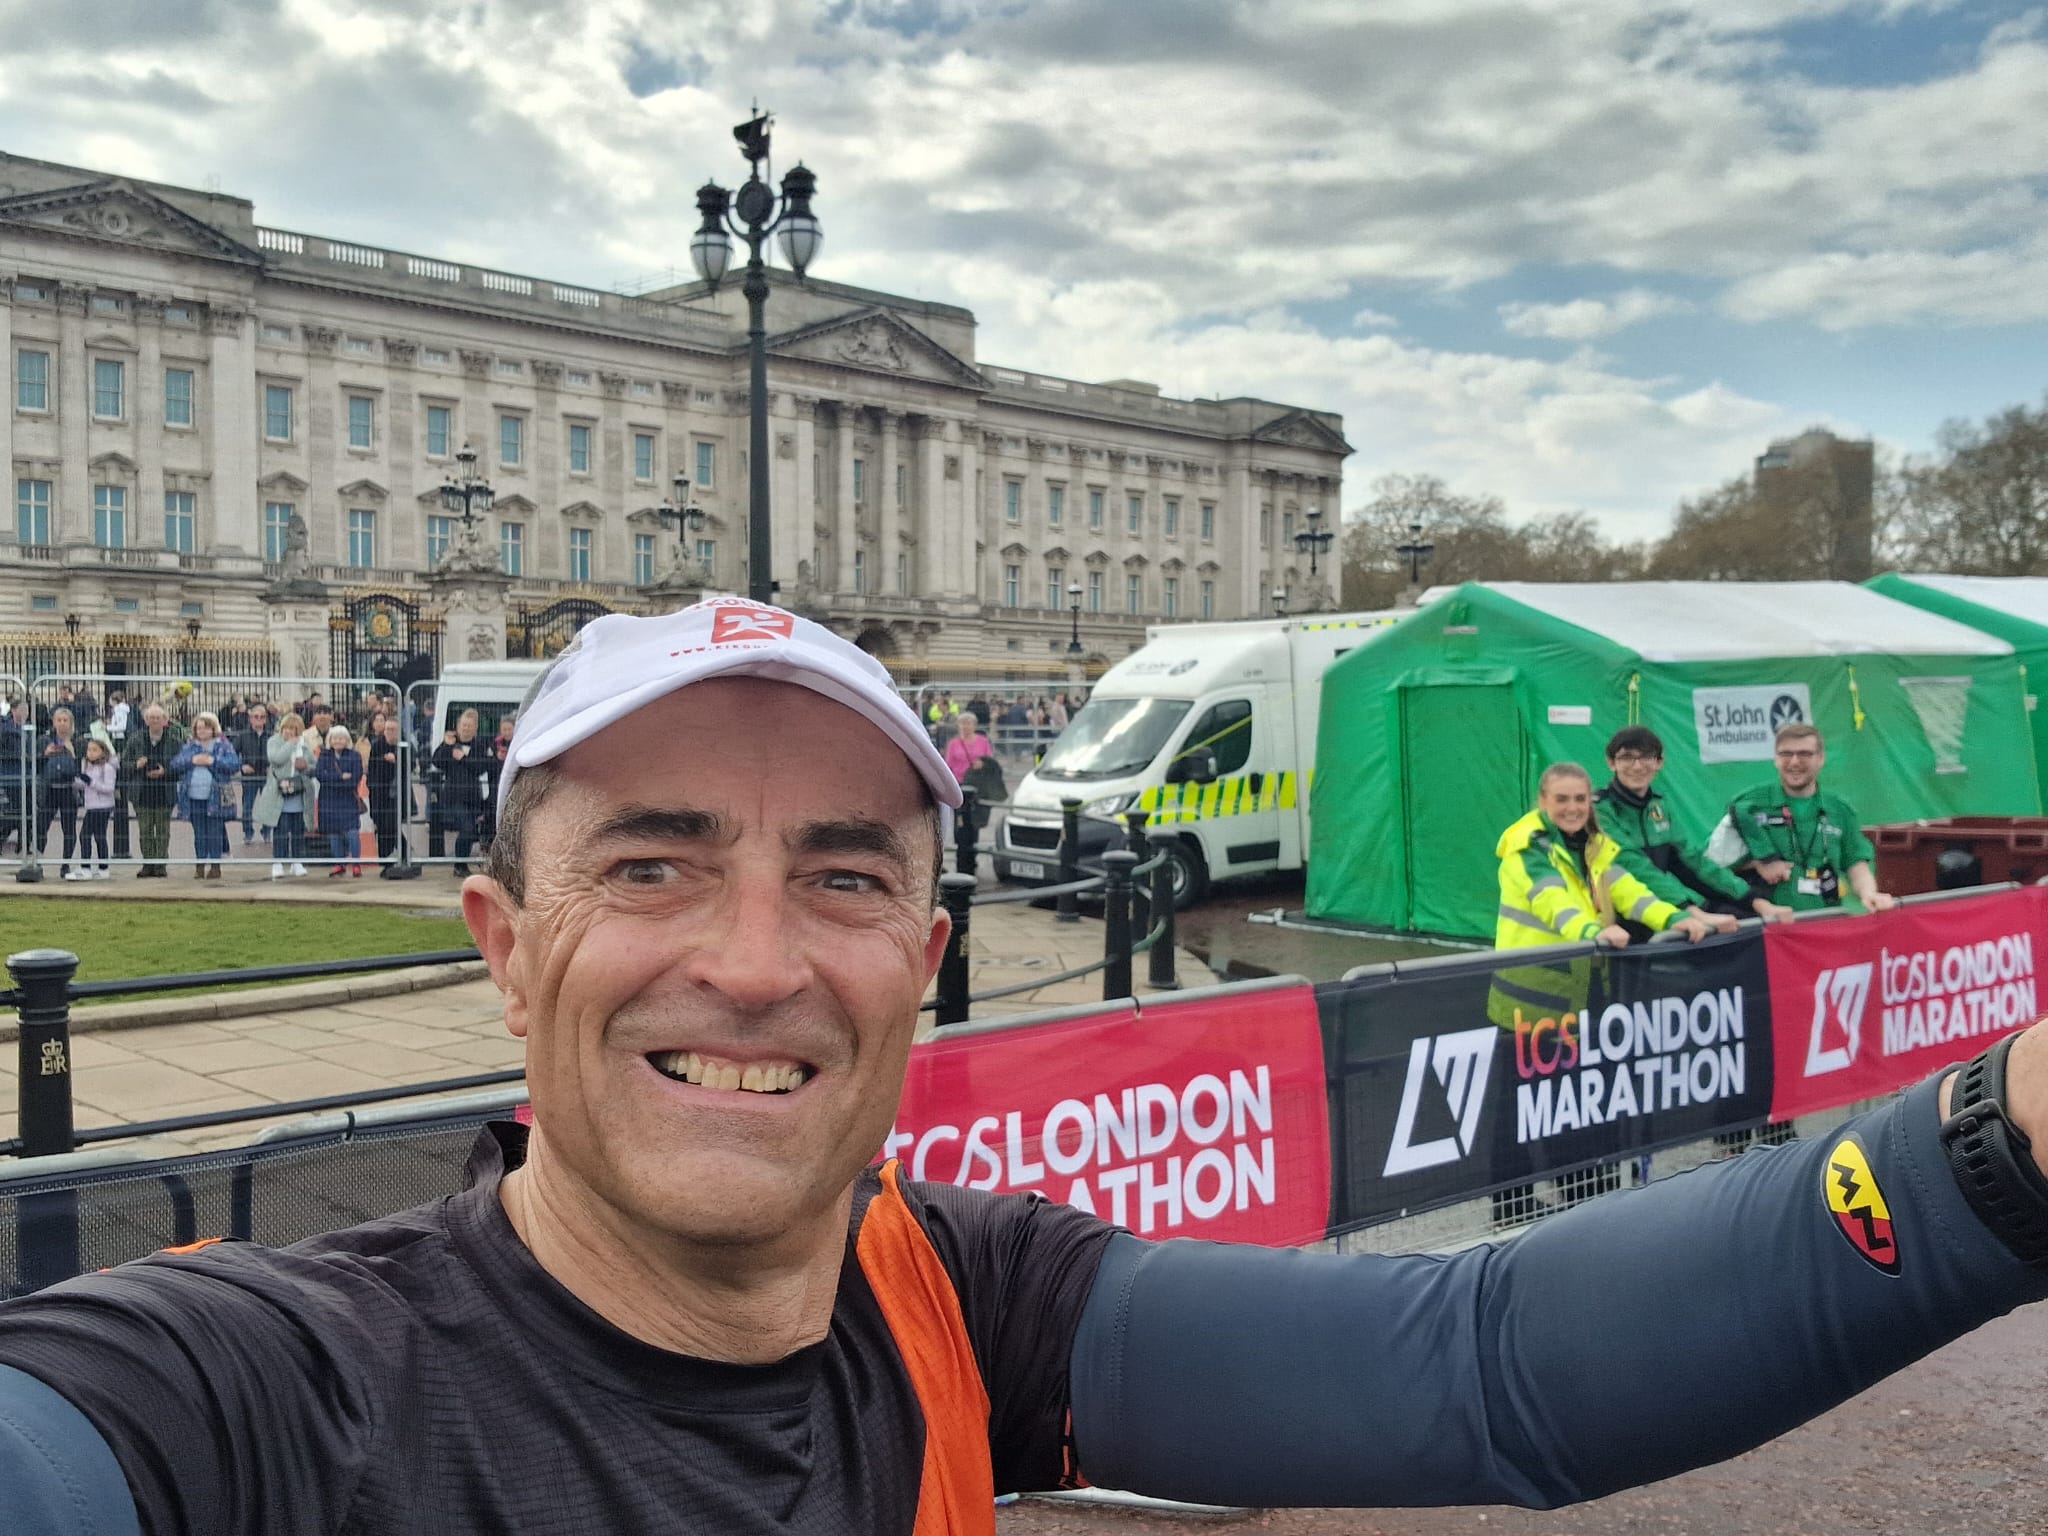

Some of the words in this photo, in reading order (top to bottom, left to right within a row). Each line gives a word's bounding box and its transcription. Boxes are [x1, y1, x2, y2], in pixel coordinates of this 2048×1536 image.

[1704, 704, 1722, 728] St
[1725, 703, 1765, 727] John
[1707, 729, 1767, 745] Ambulance
[1881, 978, 2037, 1056] MARATHON
[1517, 1042, 1745, 1143] MARATHON
